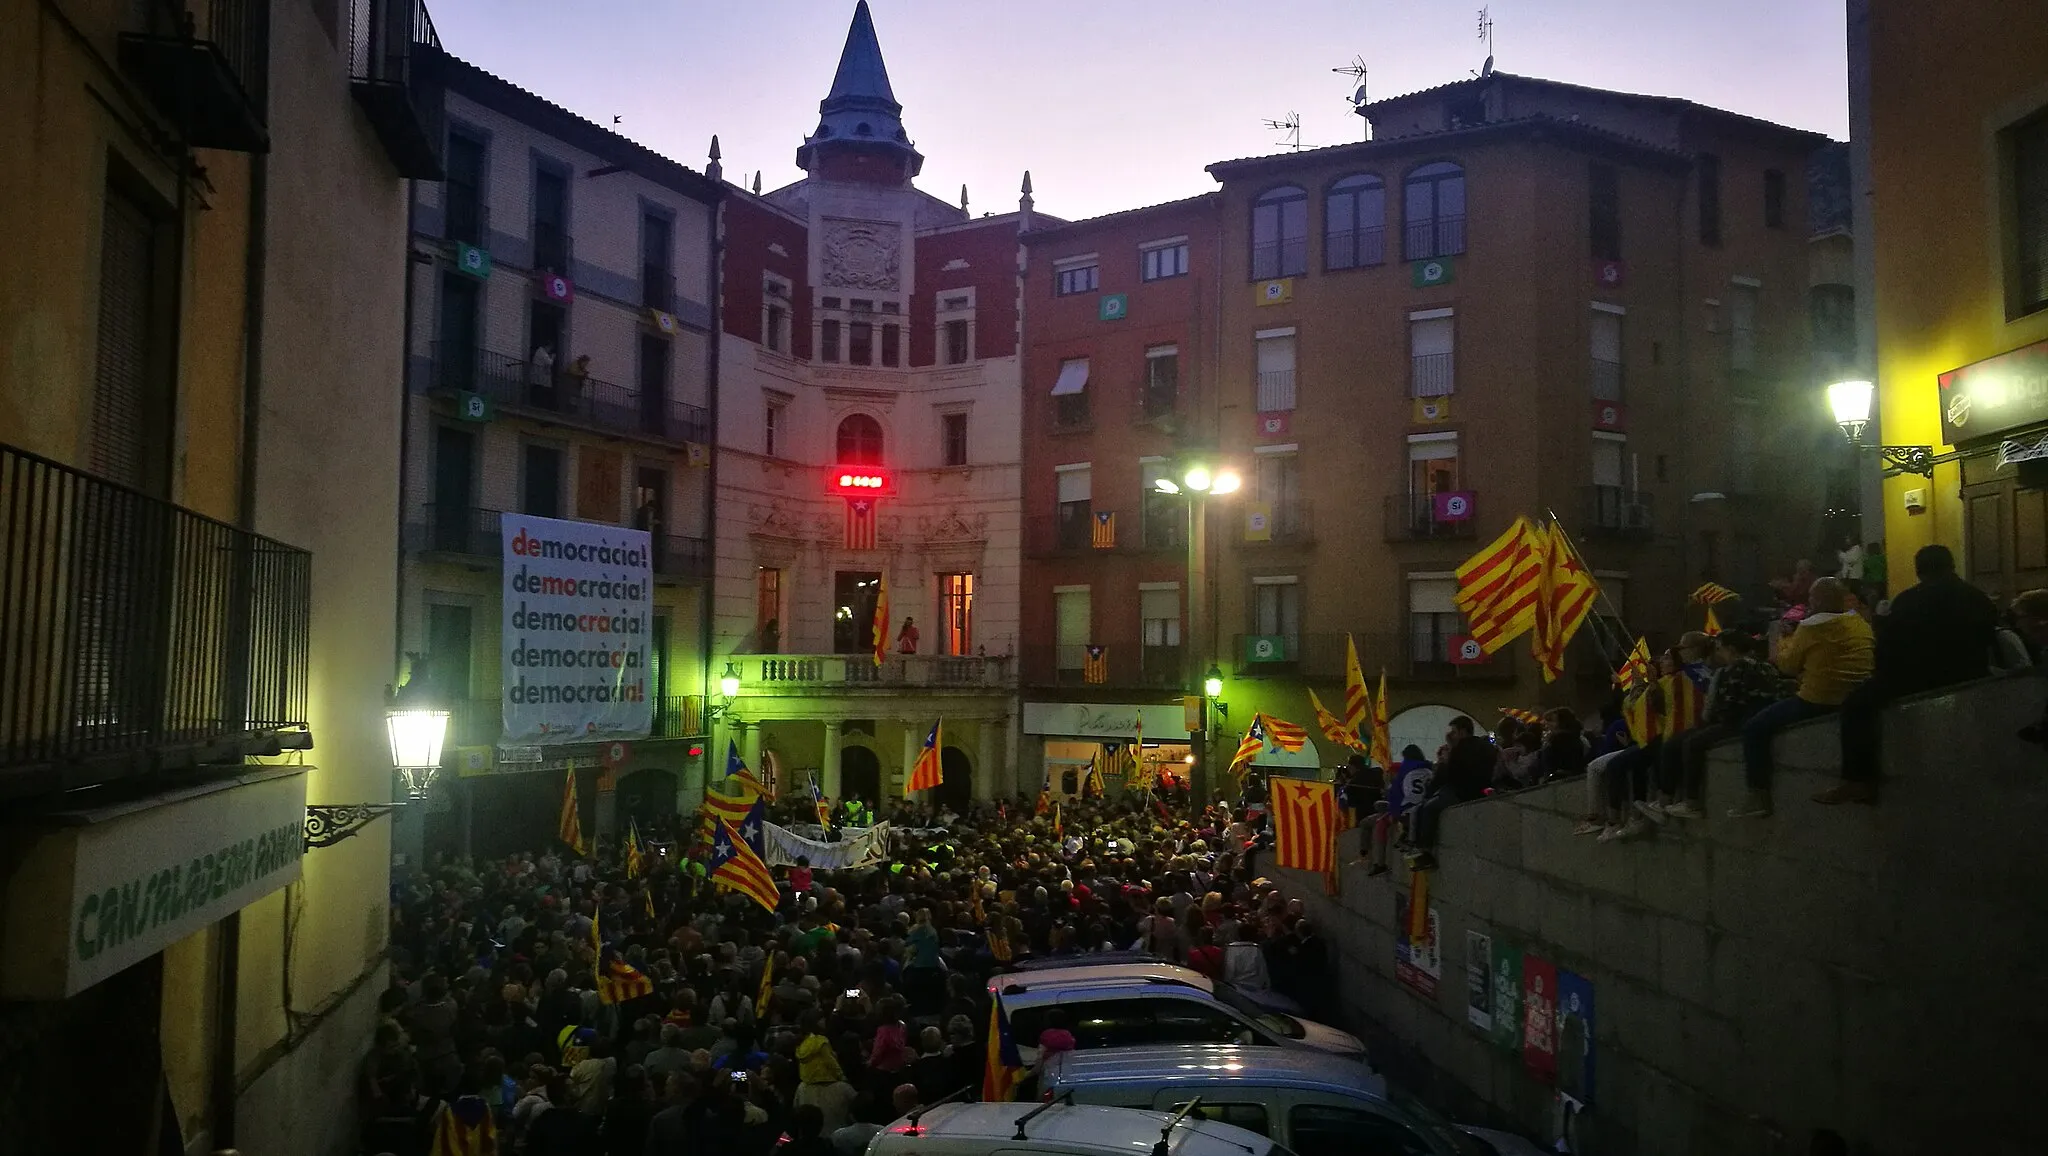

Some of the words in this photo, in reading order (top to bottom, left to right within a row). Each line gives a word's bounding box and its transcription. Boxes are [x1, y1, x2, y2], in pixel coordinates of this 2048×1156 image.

[511, 527, 647, 568] democràcia!
[512, 564, 646, 602] democràcia!
[511, 600, 646, 635] democràcia!
